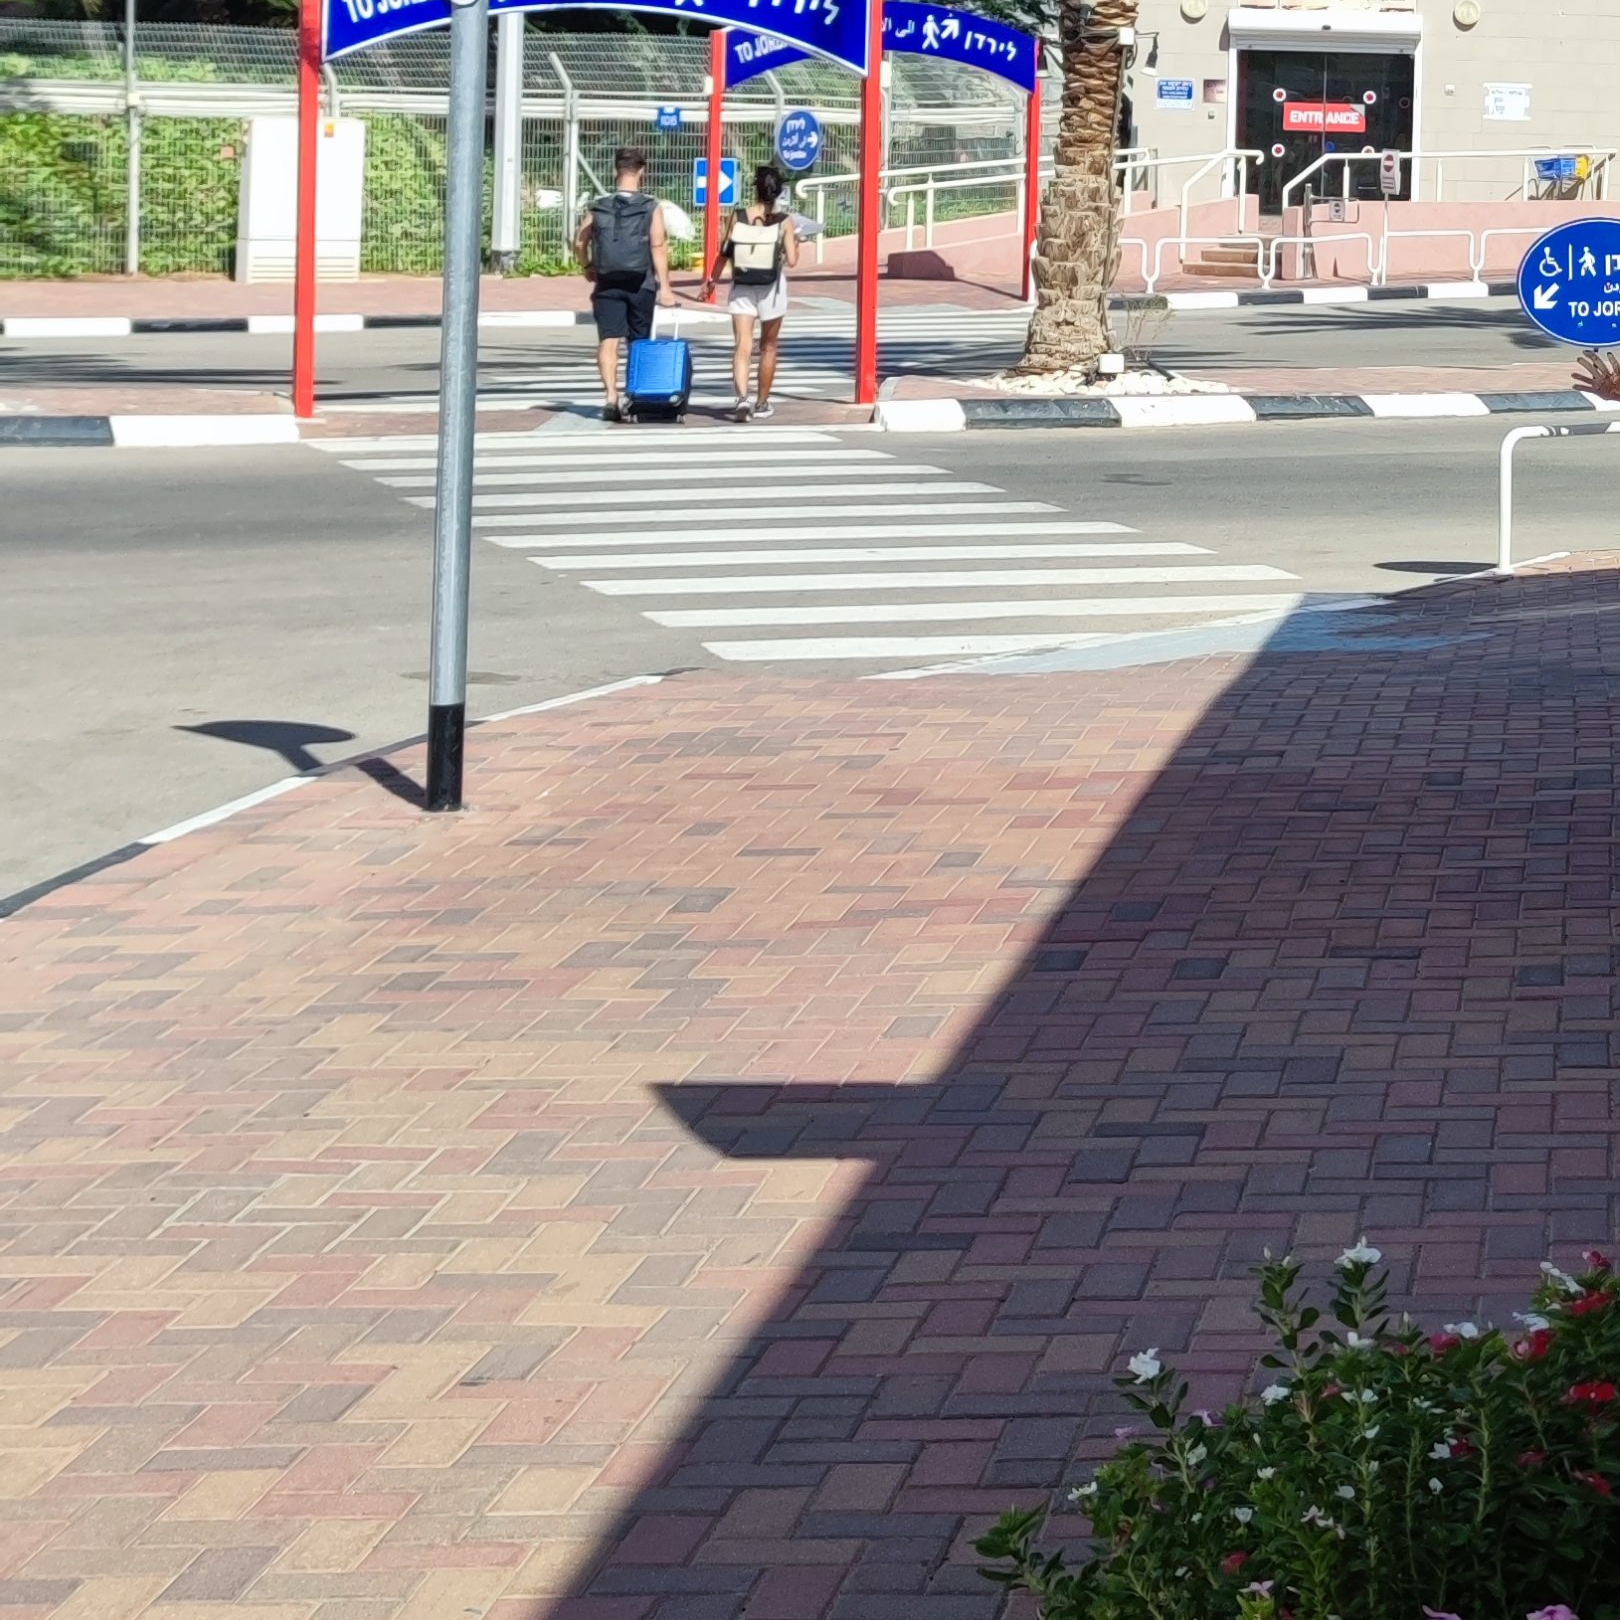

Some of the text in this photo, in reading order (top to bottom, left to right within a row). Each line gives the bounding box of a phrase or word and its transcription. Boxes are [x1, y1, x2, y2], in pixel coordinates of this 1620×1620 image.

[733, 41, 754, 64] TO
[963, 30, 1017, 62] לירדן
[1289, 110, 1361, 126] ENTRANCE
[1567, 301, 1590, 318] TO
